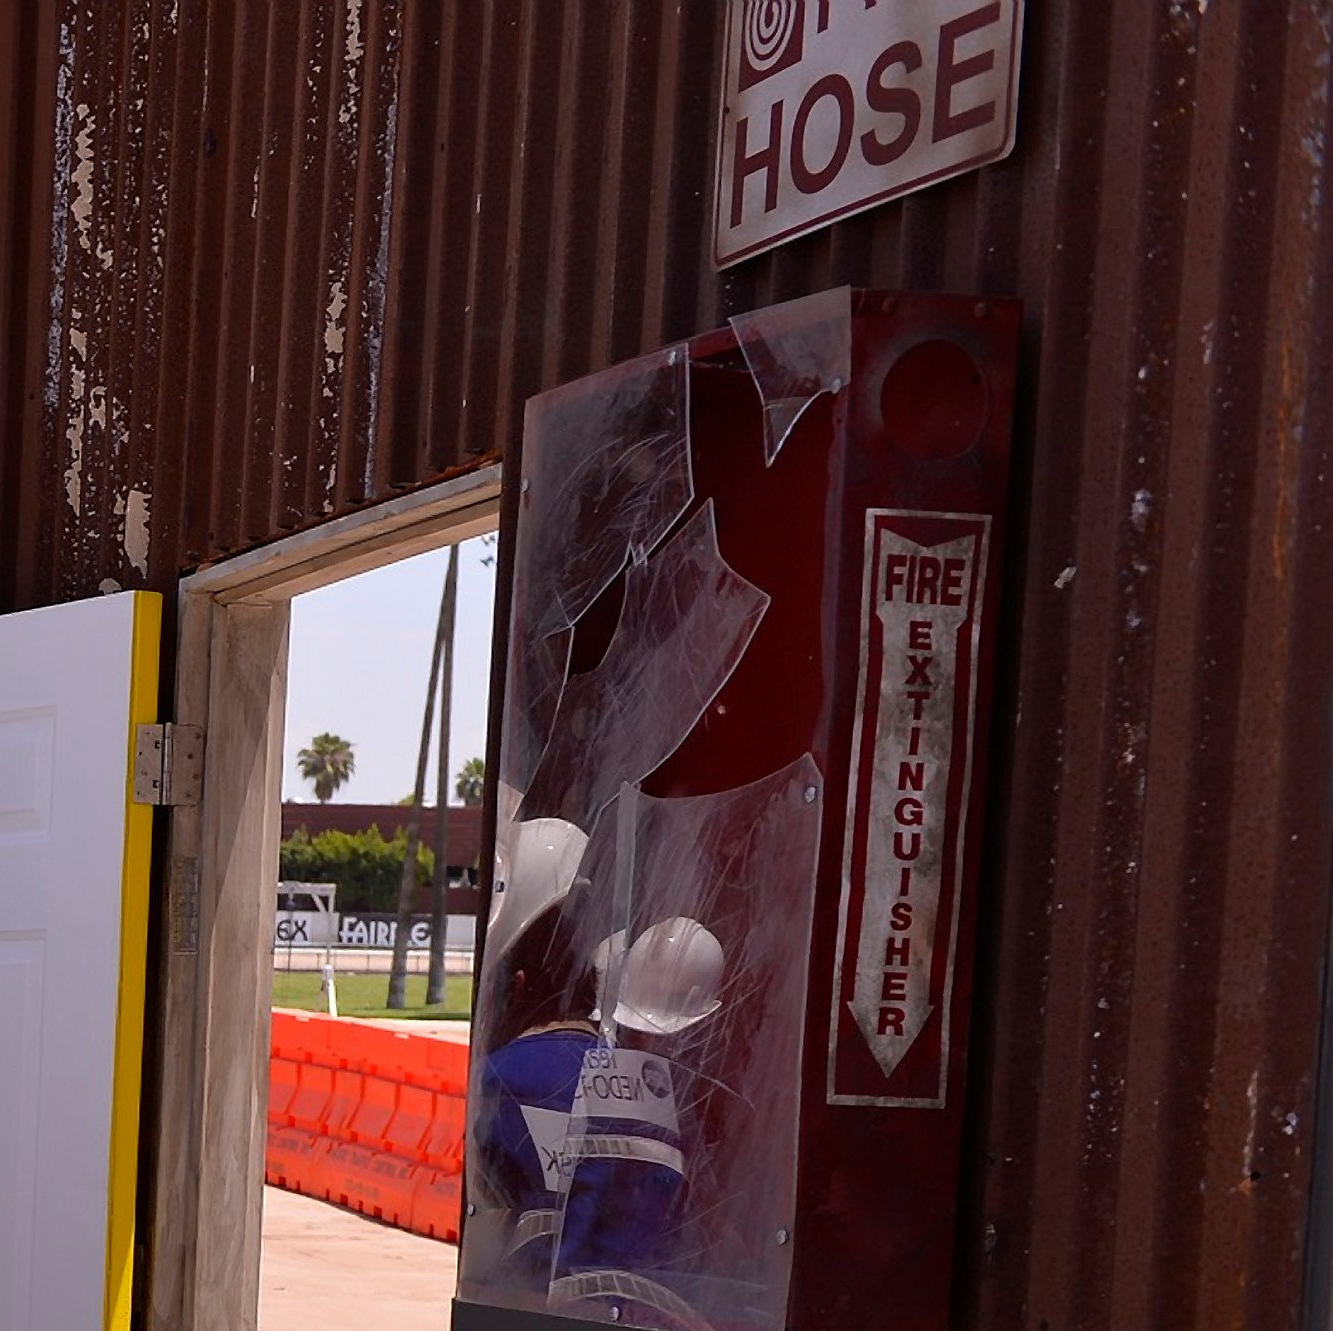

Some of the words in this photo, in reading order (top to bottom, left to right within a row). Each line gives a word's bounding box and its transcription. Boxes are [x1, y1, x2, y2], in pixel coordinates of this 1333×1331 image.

[730, 1, 1002, 229] HOSE
[884, 554, 966, 606] FIRE
[876, 620, 933, 1036] EXTINGUISHER
